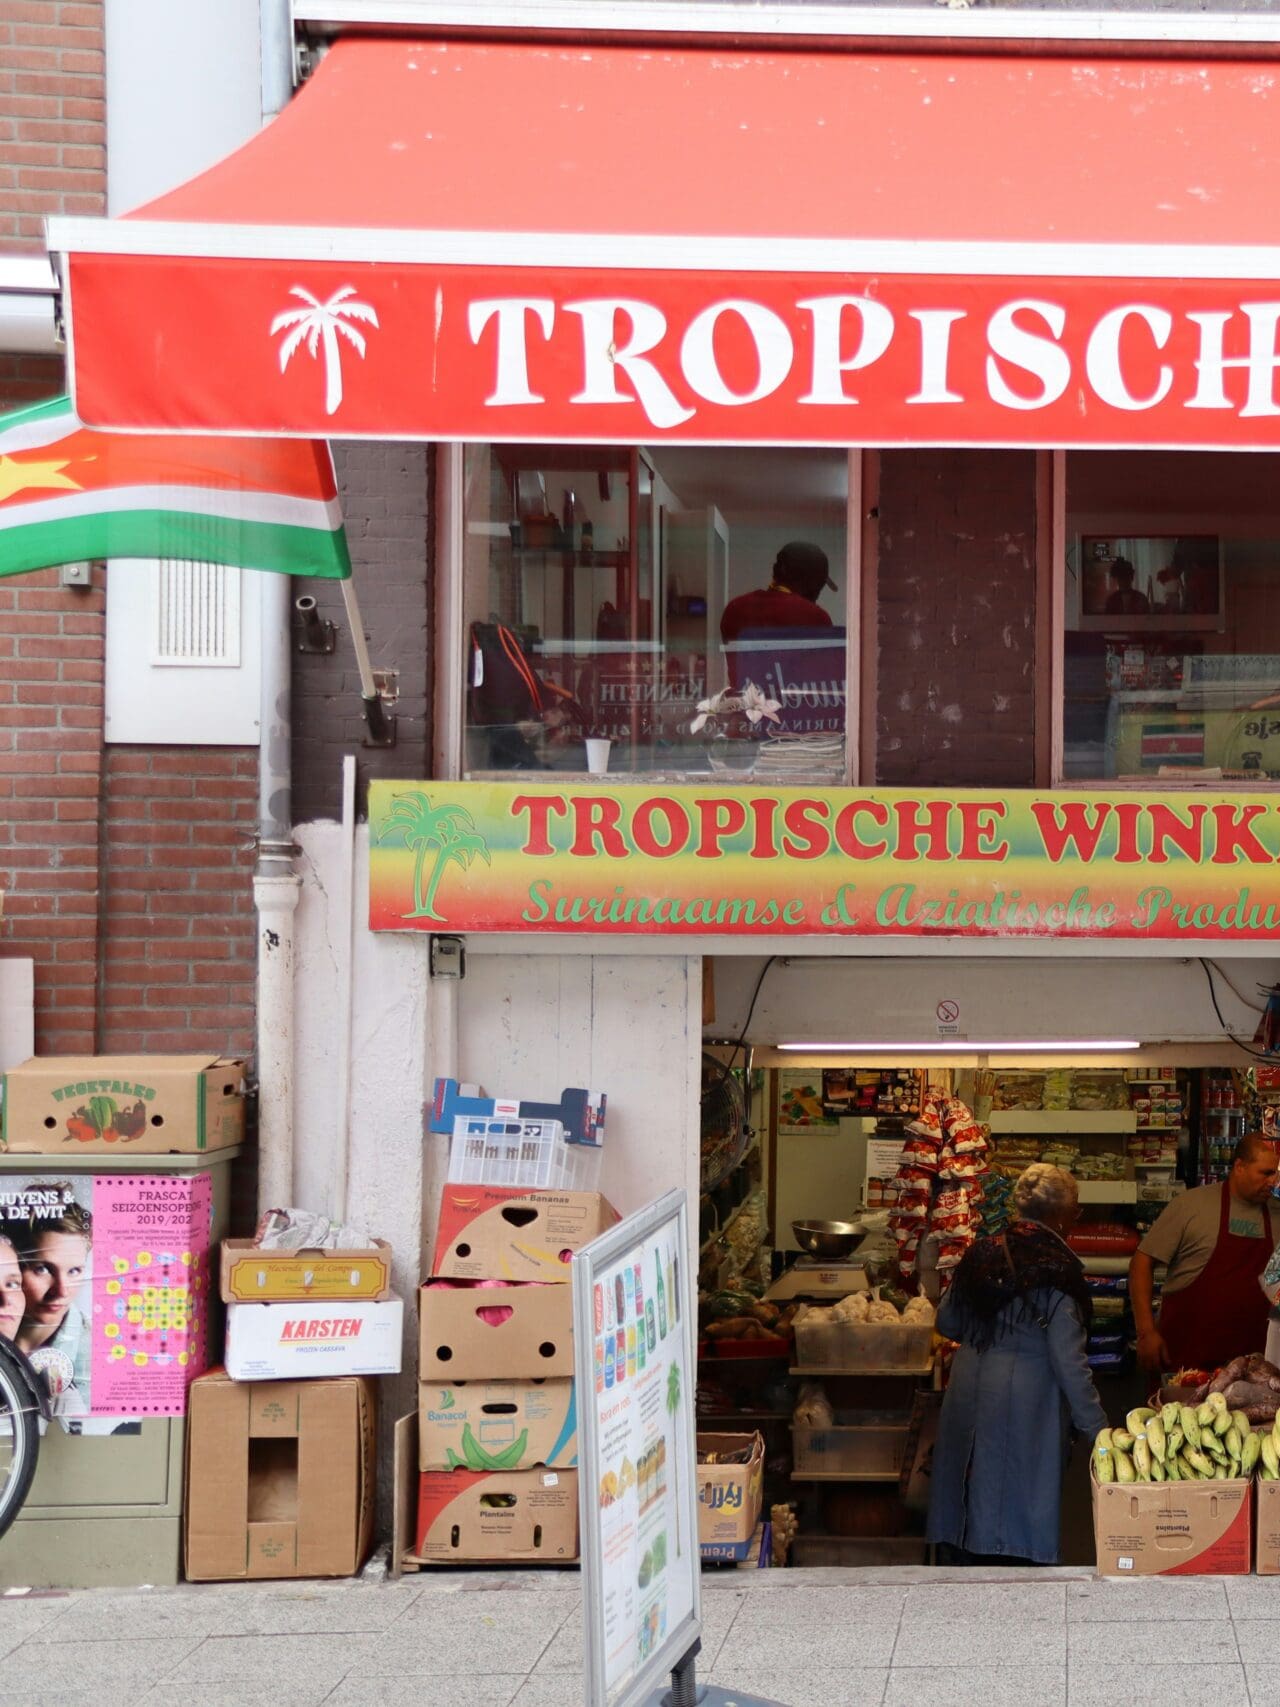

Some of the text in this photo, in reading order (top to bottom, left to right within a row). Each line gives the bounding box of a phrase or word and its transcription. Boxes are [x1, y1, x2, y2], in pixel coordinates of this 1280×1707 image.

[510, 795, 1009, 862] TROPISCHE
[521, 879, 805, 926] Surinaamse
[820, 883, 859, 926] &
[876, 883, 1115, 929] Aziatische
[51, 1080, 157, 1102] VEGETALES
[63, 1191, 75, 1204] &
[138, 1191, 193, 1201] FRASCAT
[530, 1194, 571, 1204] Bananas
[8, 1206, 30, 1219] DE
[33, 1205, 66, 1219] WIT
[137, 1214, 193, 1225] 2019/202
[280, 1318, 363, 1339] KARSTEN
[427, 1410, 467, 1421] Banacol
[700, 1546, 736, 1559] Prem
